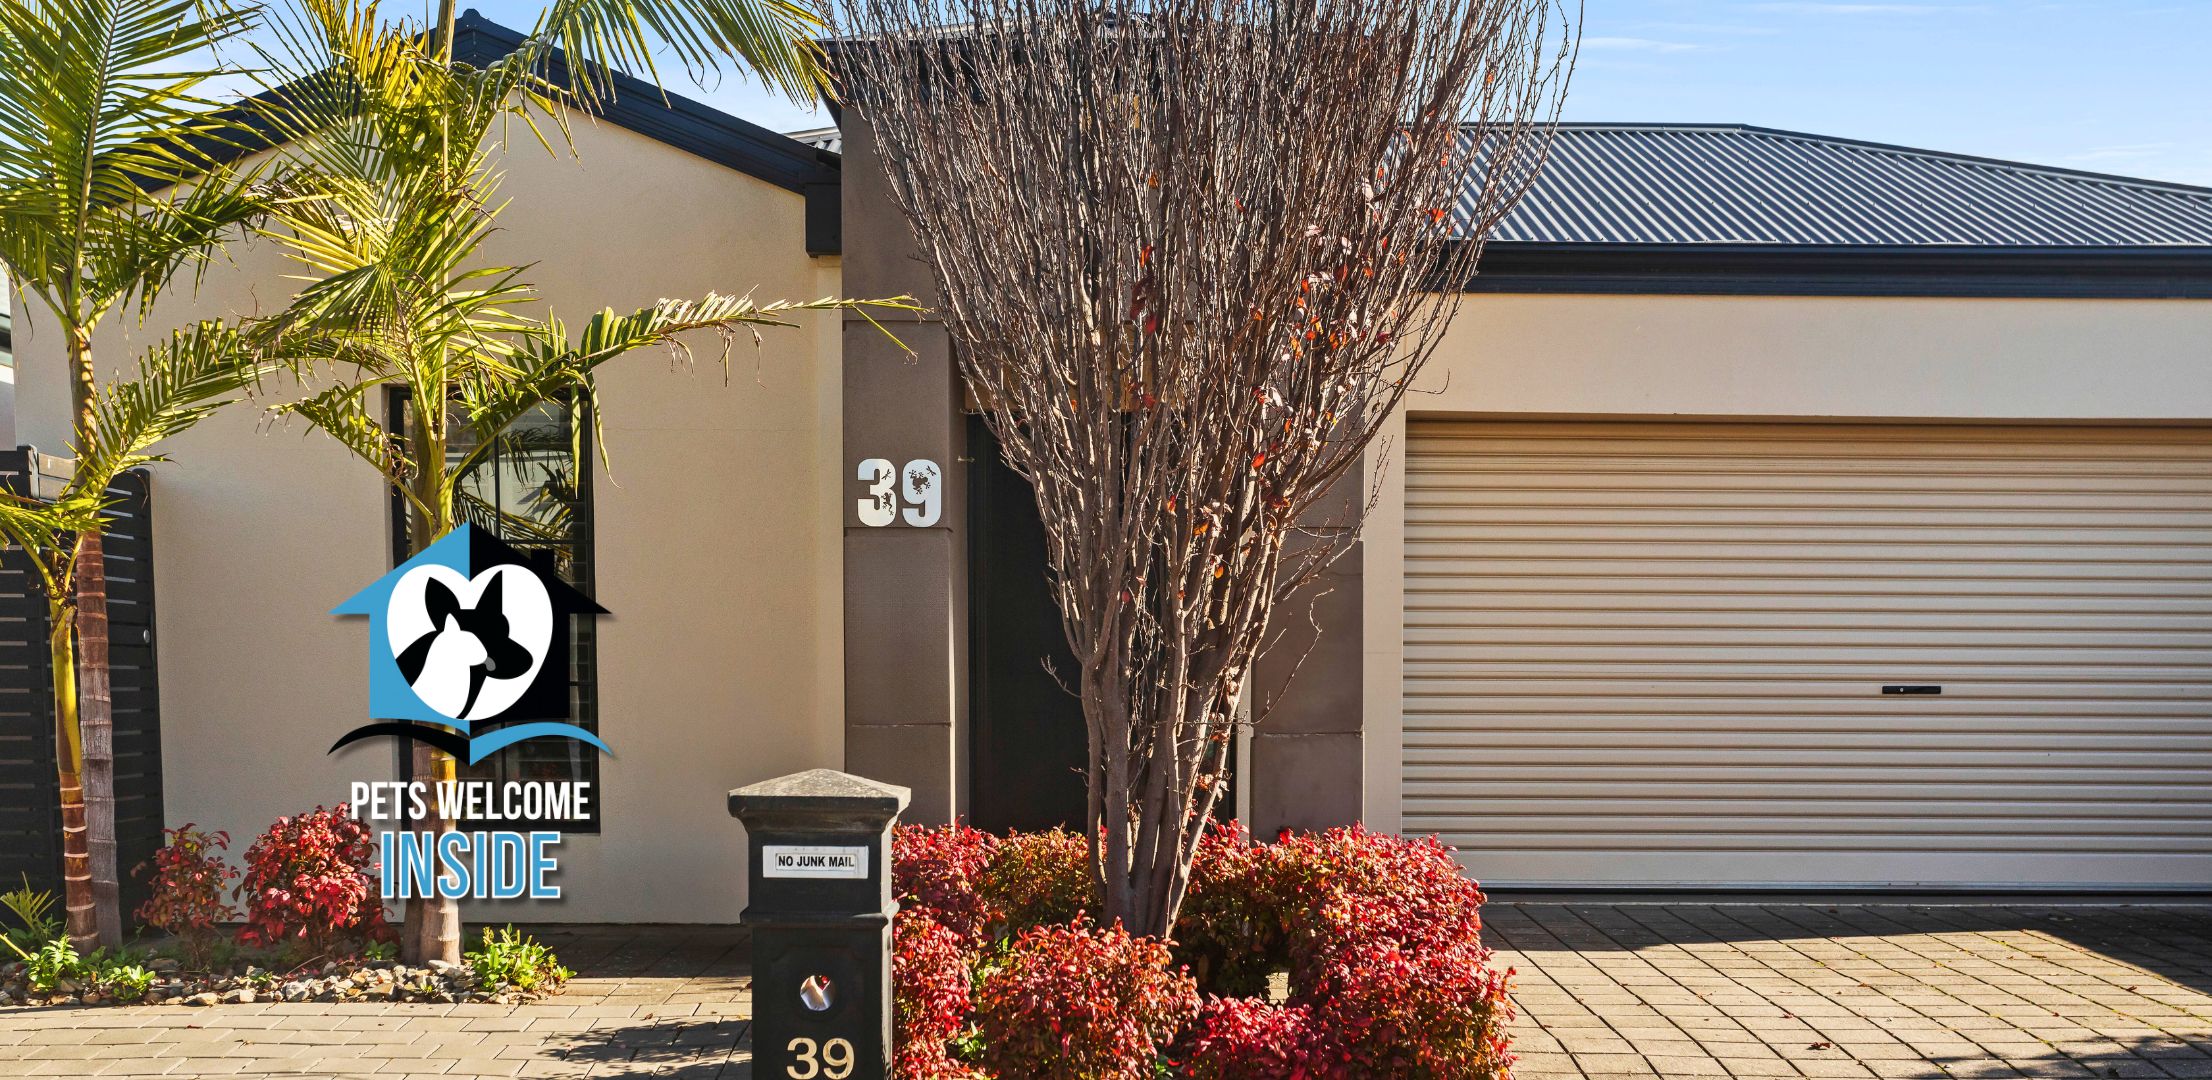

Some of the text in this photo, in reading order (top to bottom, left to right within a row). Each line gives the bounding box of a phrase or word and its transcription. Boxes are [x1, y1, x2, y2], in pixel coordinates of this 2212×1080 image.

[857, 458, 942, 528] 39
[778, 856, 855, 868] NO JUNK MAIL
[786, 1037, 855, 1080] 39
